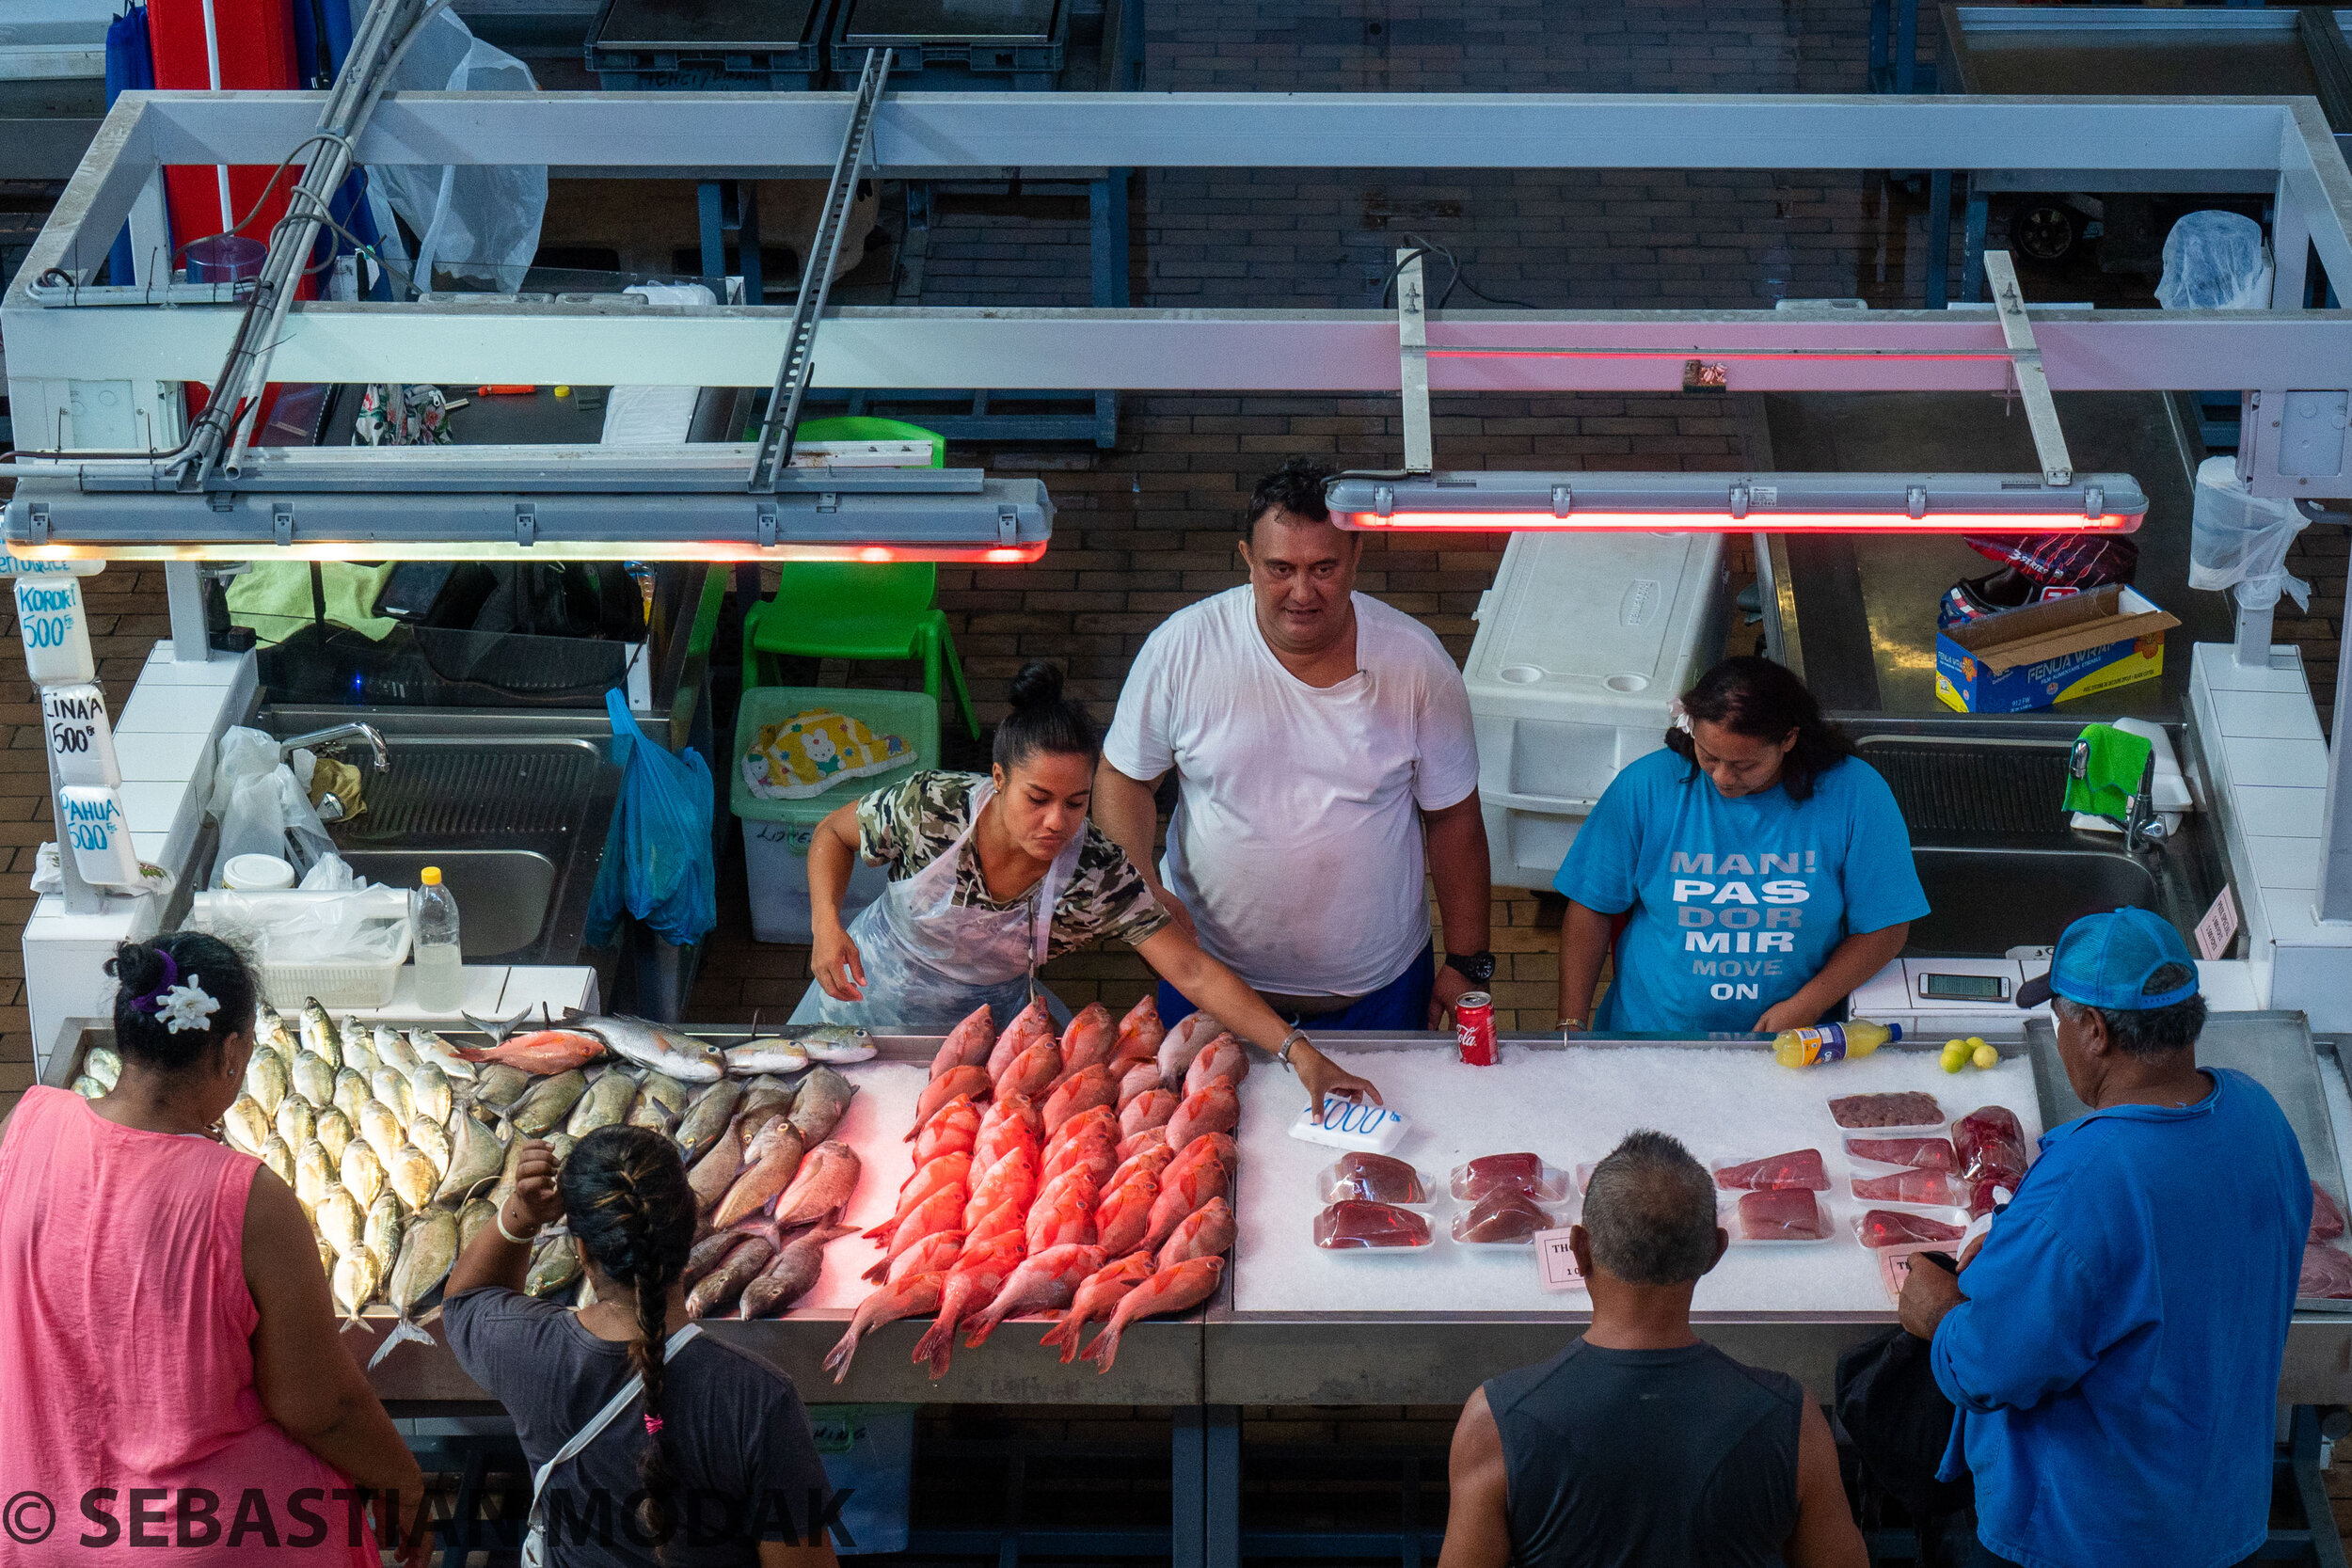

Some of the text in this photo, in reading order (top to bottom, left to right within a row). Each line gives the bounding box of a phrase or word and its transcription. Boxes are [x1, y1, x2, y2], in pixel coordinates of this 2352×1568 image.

[24, 615, 64, 648] 500
[53, 722, 88, 753] 500
[68, 822, 108, 850] 500
[1670, 850, 1817, 876] MAN!
[1673, 879, 1810, 905] PAS
[1678, 906, 1804, 929] DOR
[1685, 931, 1795, 954] MIR
[1692, 959, 1784, 977] MOVE
[1710, 983, 1758, 1001] ON
[1551, 1243, 1568, 1253] TH
